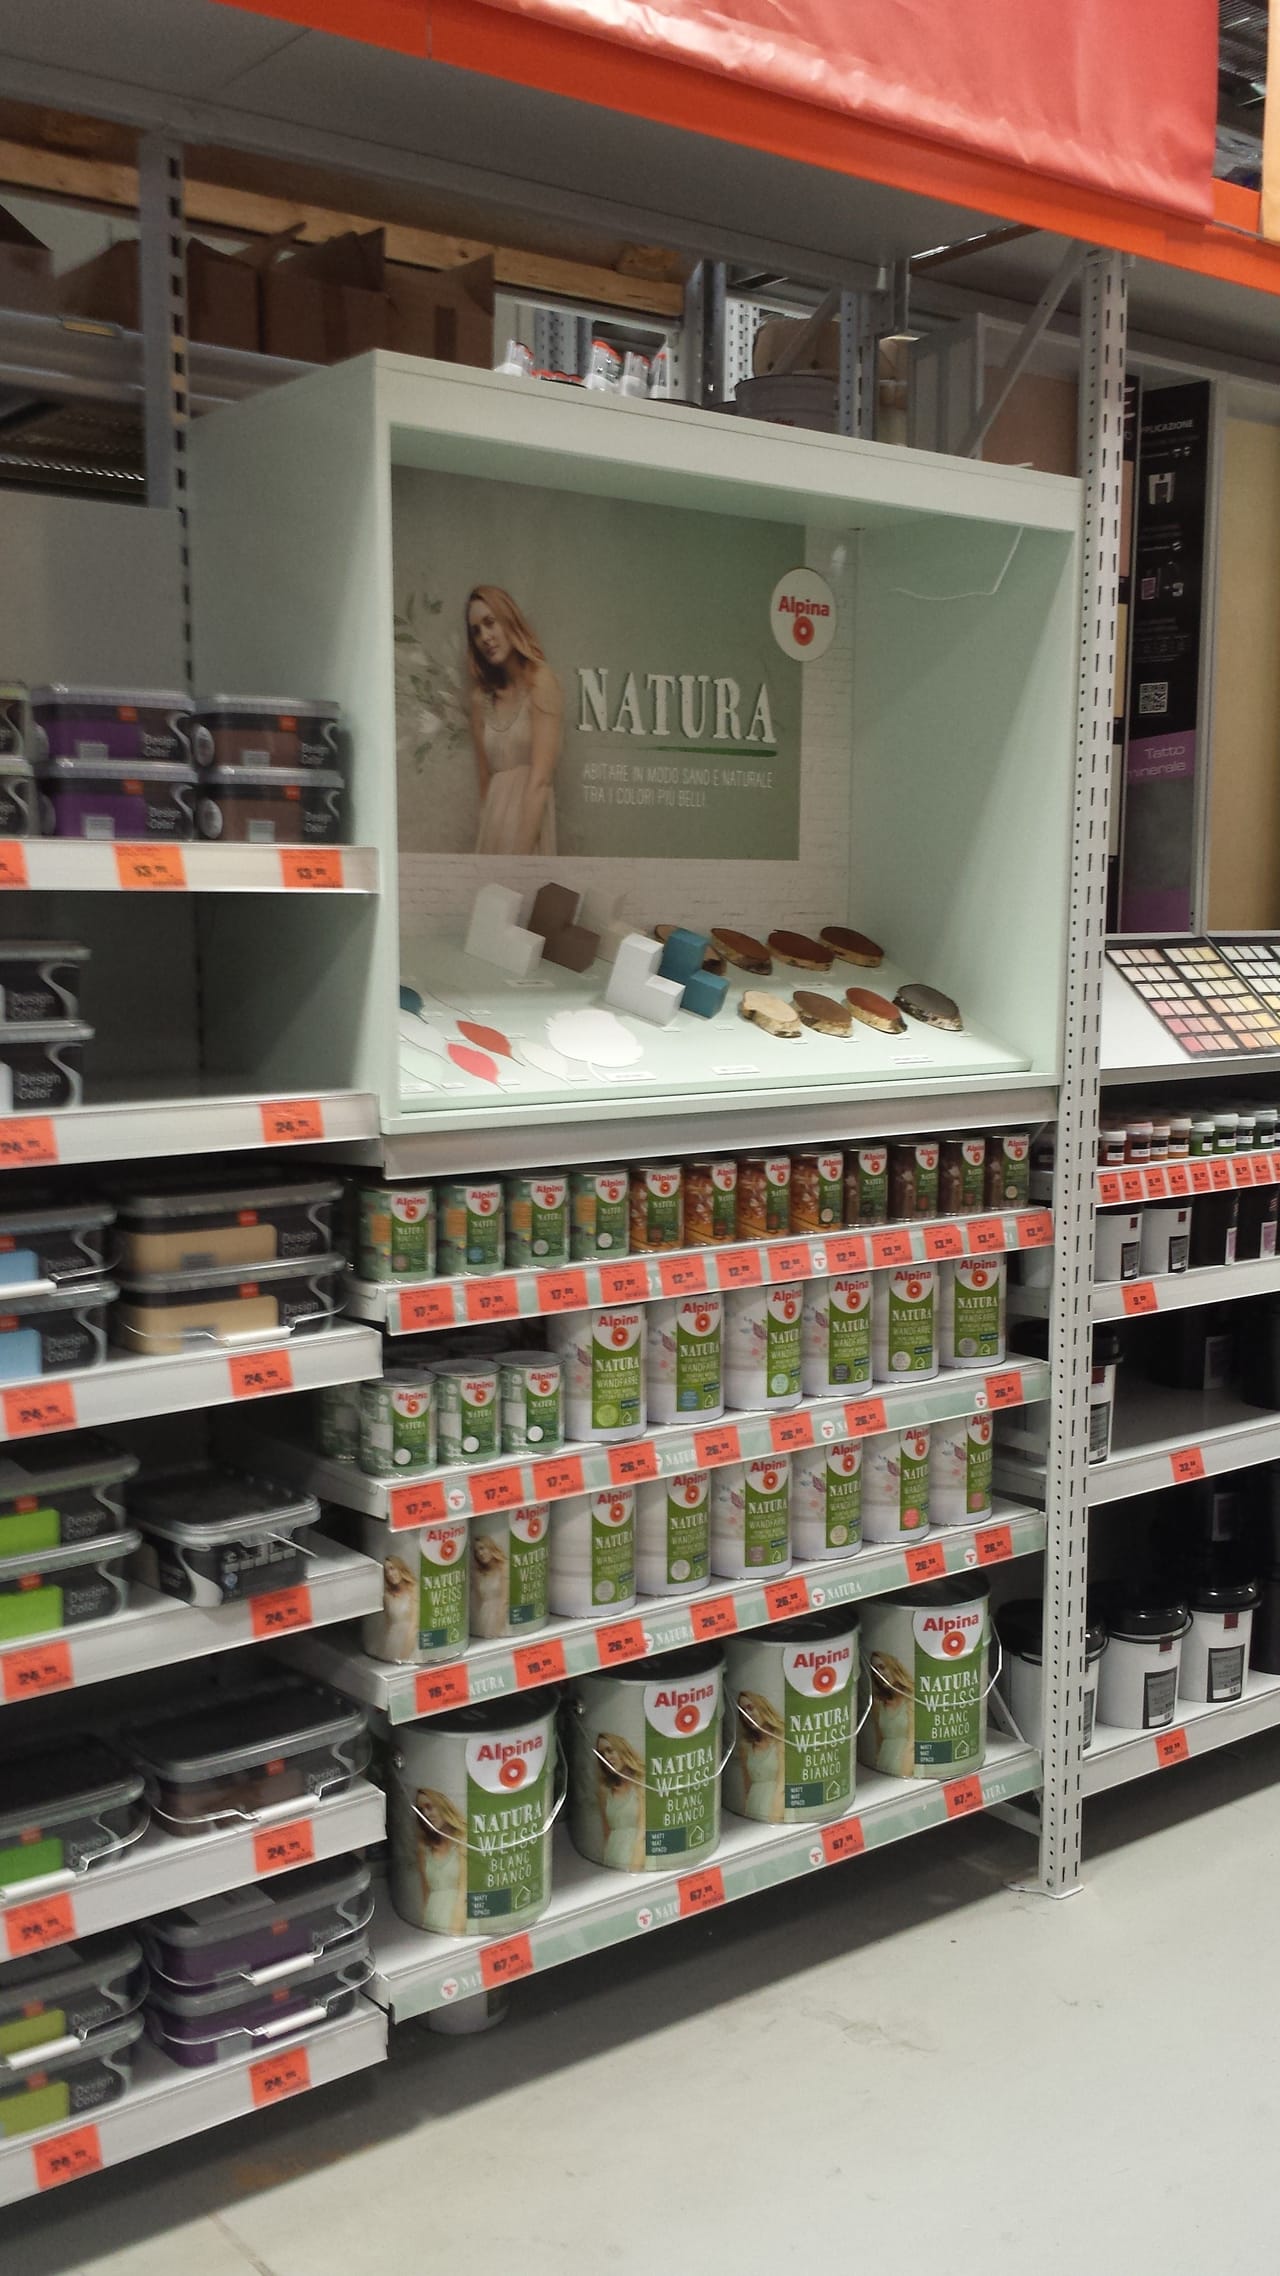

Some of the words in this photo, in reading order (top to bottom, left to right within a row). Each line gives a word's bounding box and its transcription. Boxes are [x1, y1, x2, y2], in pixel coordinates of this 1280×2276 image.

[778, 595, 830, 619] Alpina
[577, 667, 776, 744] NATURA
[584, 763, 628, 782] ABITARE
[648, 766, 679, 785] MODO
[682, 768, 710, 786] SANO
[722, 769, 773, 789] NATURALE
[960, 1259, 997, 1271] Alpina
[894, 1271, 932, 1282] Alpina
[612, 1279, 635, 1291] 17.
[834, 1280, 869, 1291] Alpina
[551, 1288, 574, 1300] 17.
[958, 1296, 998, 1308] NATURA
[682, 1301, 719, 1314] Alpina
[892, 1308, 932, 1321] NATURA
[598, 1314, 639, 1328] Alpina
[832, 1319, 869, 1333] NATURA
[680, 1342, 720, 1357] NATURA
[595, 1356, 640, 1373] NATURA
[530, 1372, 558, 1382] Alpina
[855, 1413, 876, 1427] 26.
[780, 1427, 804, 1441] 26.
[704, 1442, 730, 1456] 26.
[620, 1459, 646, 1472] 26.
[751, 1459, 787, 1473] Alpina
[546, 1474, 570, 1486] 17.
[672, 1474, 707, 1487] Alpina
[485, 1485, 509, 1499] 17.
[597, 1490, 632, 1505] Alpina
[406, 1500, 433, 1515] 17.
[749, 1500, 787, 1515] NATURA
[427, 1526, 465, 1542] Alpina
[915, 1558, 936, 1571] 26.
[431, 1584, 462, 1606] WEISS
[776, 1593, 798, 1608] 26.
[702, 1613, 726, 1628] 26.
[923, 1613, 979, 1635] Alpina
[608, 1639, 633, 1652] 26.
[793, 1648, 850, 1671] Alpina
[469, 1675, 505, 1696] ATURA
[919, 1668, 978, 1693] NATURA
[654, 1685, 714, 1709] Alpina
[924, 1688, 976, 1713] WEISS
[790, 1705, 849, 1732] NATURA
[934, 1710, 969, 1726] BLANC
[931, 1721, 970, 1739] BIANCO
[795, 1725, 847, 1753] WEISS
[477, 1735, 543, 1763] Alpina
[651, 1745, 713, 1775] NATURA
[805, 1749, 839, 1767] BLANC
[802, 1762, 841, 1781] BIANCO
[656, 1767, 710, 1798] WEISS
[667, 1792, 703, 1812] BLANC
[953, 1791, 974, 1806] 67.
[472, 1800, 543, 1833] NATURA
[664, 1805, 705, 1827] BIANCO
[478, 1823, 538, 1856] WEISS
[832, 1834, 854, 1850] 67.
[491, 1851, 530, 1873] BLANC
[487, 1865, 532, 1888] BIANCO
[688, 1884, 714, 1902] 67.
[492, 1953, 521, 1972] 67.
